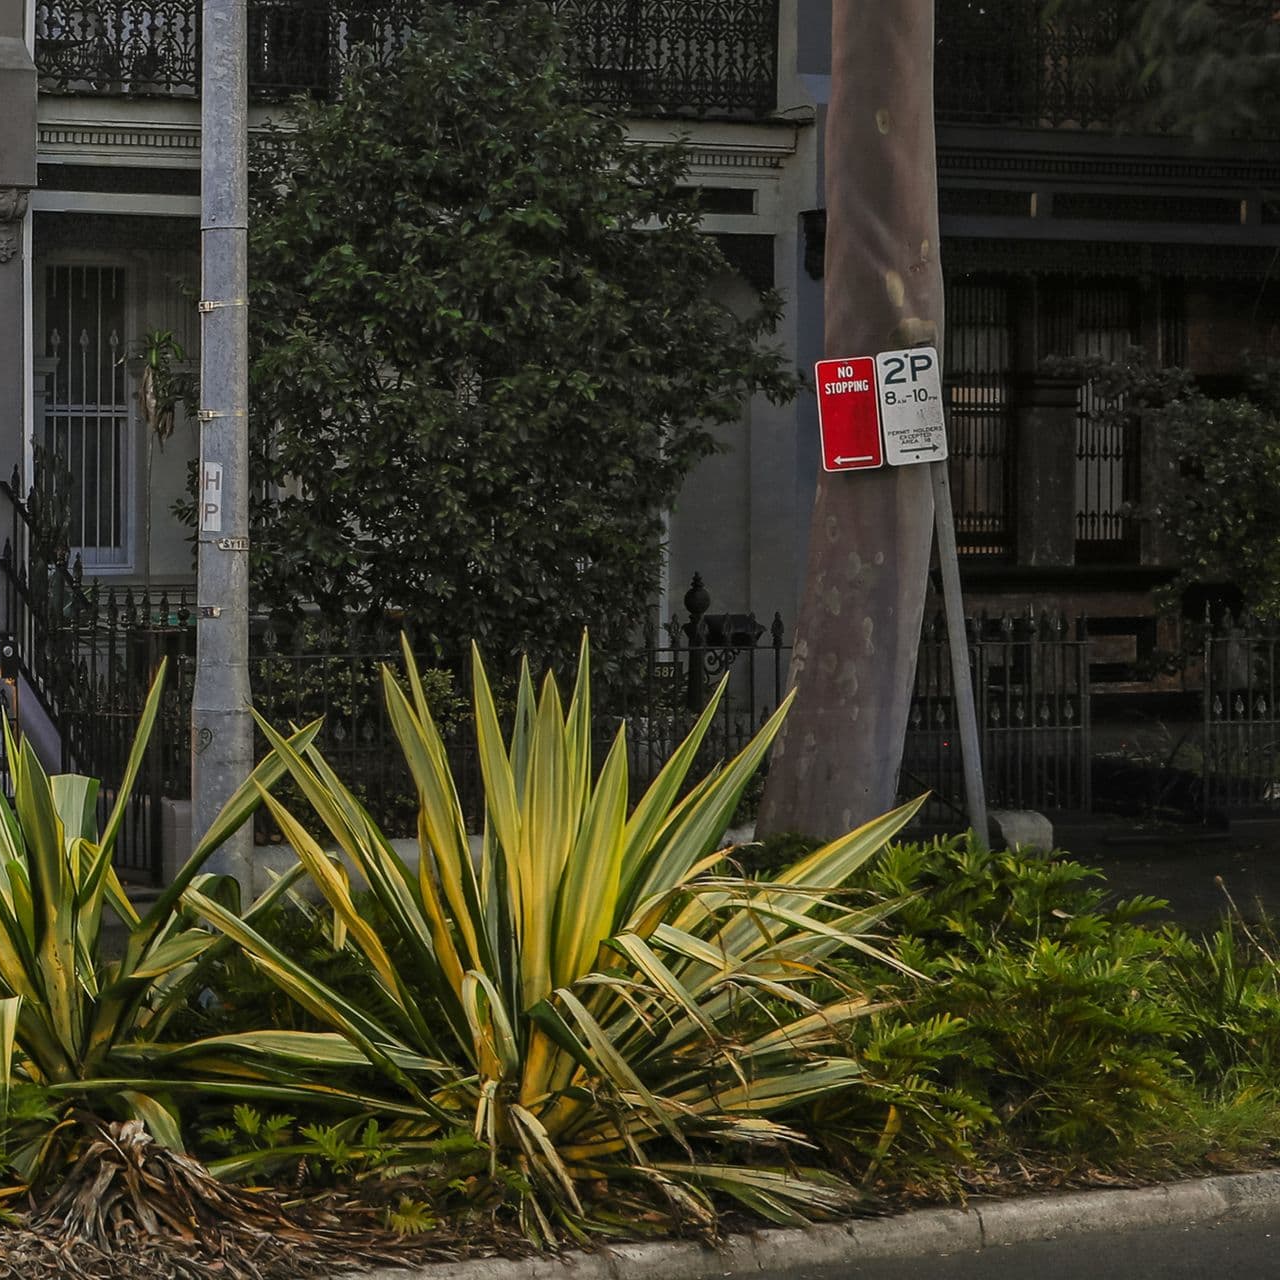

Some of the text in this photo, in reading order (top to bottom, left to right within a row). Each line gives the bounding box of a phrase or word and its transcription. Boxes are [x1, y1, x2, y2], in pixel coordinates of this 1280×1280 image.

[837, 365, 854, 379] NO
[883, 354, 933, 385] 2P
[824, 379, 870, 395] STOPPING
